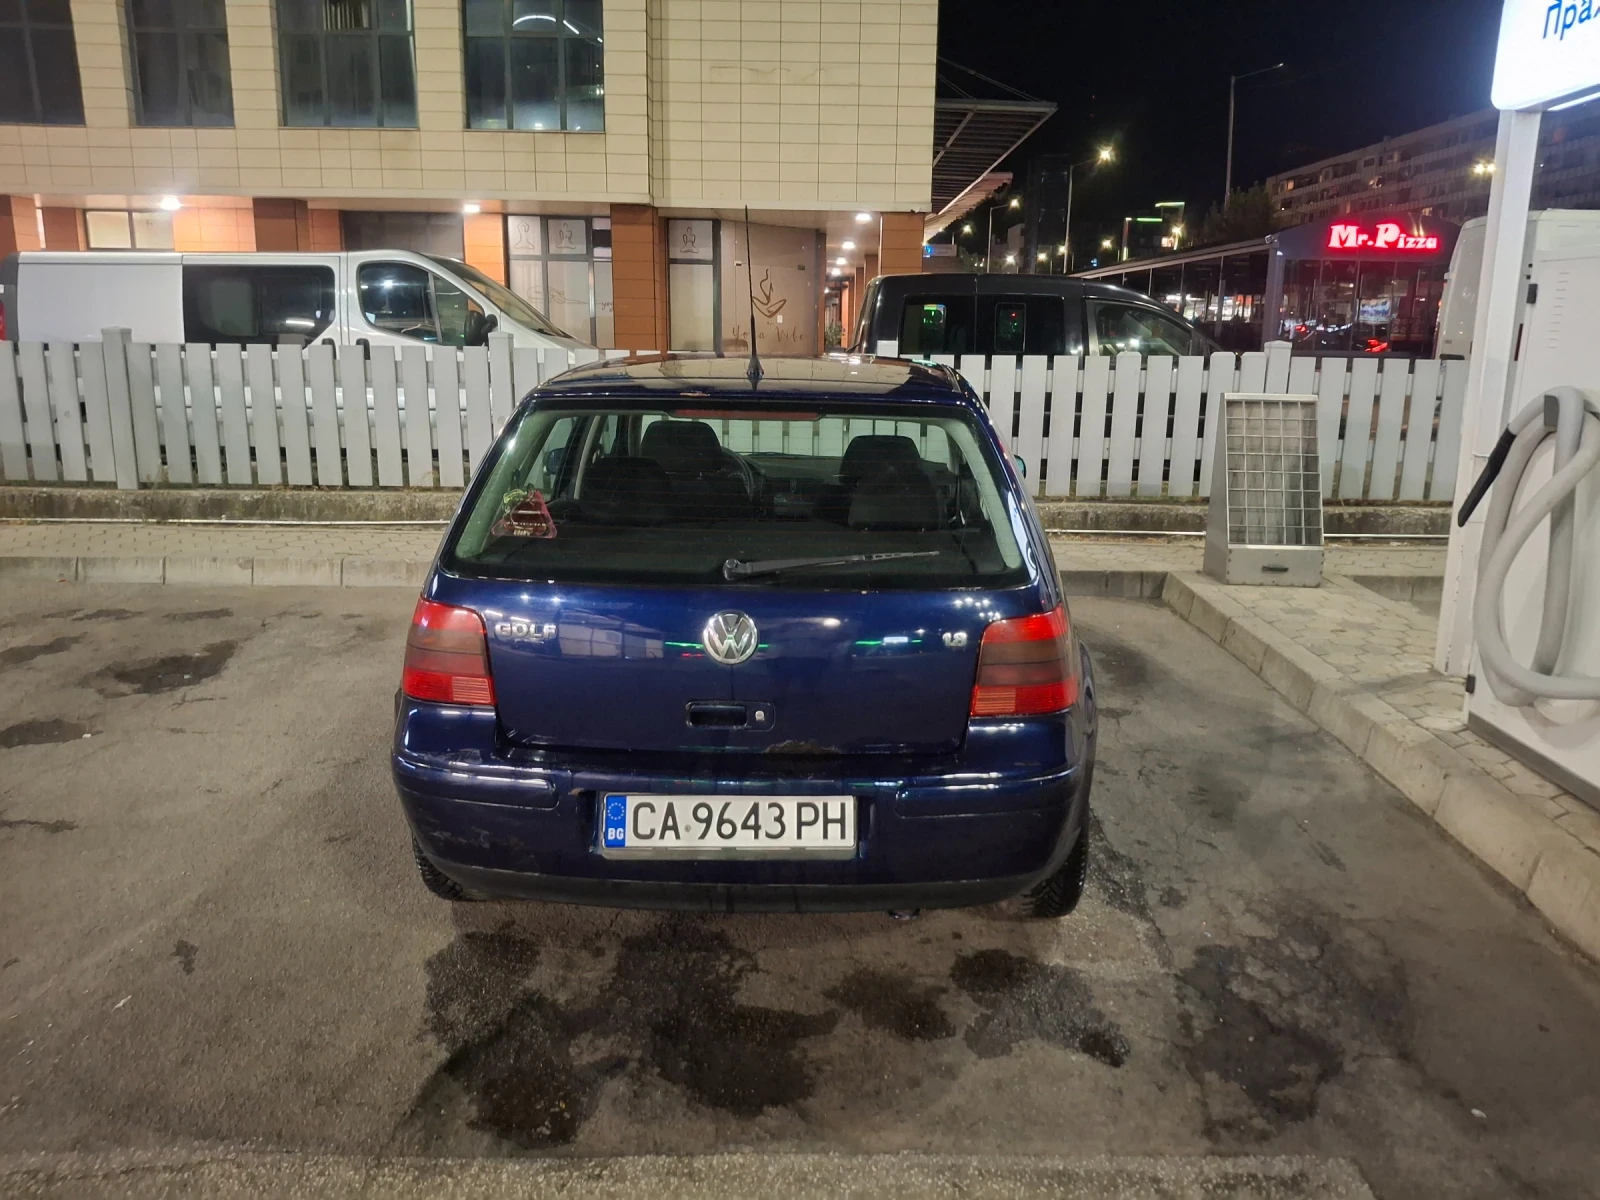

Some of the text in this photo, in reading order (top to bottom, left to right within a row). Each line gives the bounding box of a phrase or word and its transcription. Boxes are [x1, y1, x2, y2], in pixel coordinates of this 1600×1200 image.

[1542, 0, 1600, 41] Пра
[494, 622, 557, 639] GOLF
[607, 827, 625, 841] BG
[632, 801, 846, 841] CA 9643 PH
